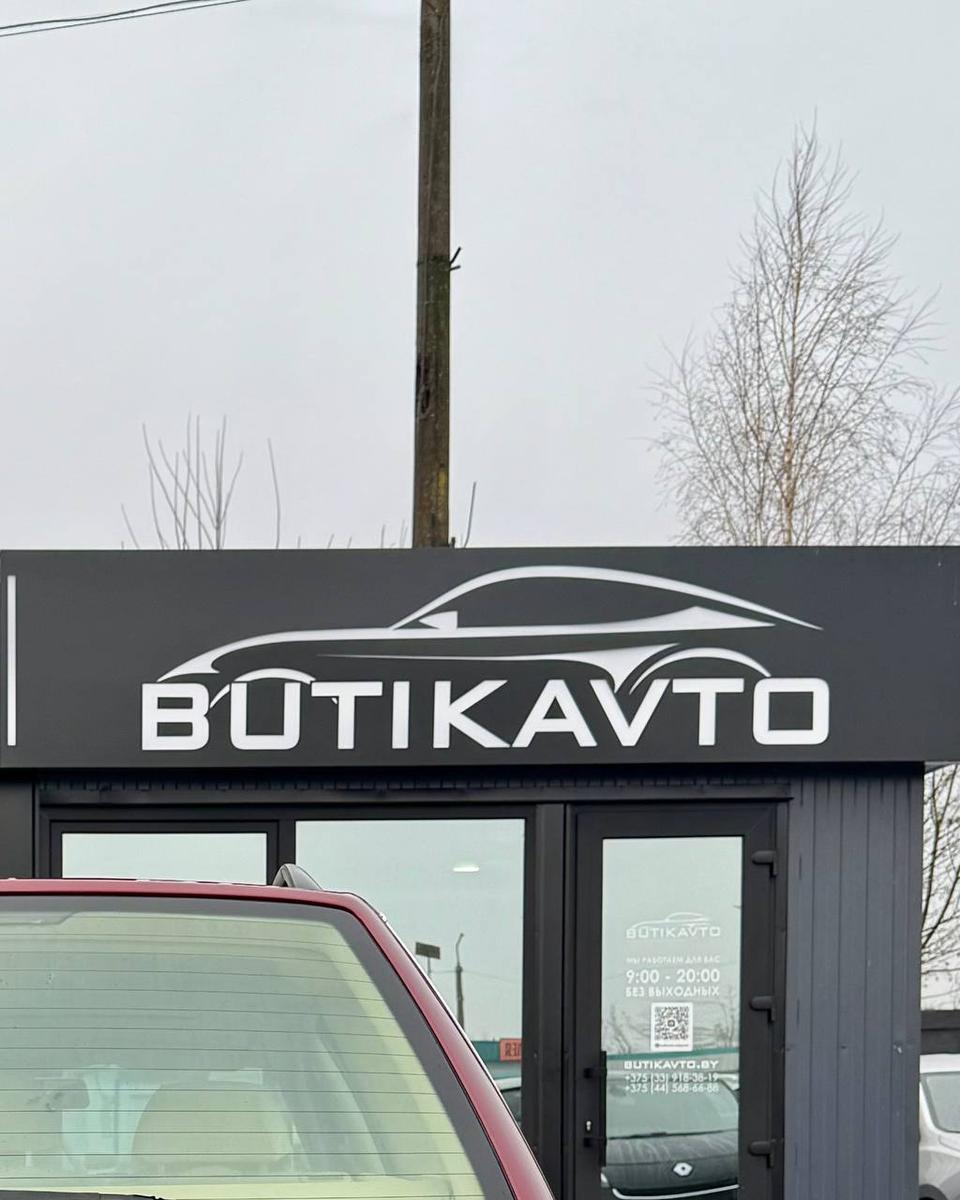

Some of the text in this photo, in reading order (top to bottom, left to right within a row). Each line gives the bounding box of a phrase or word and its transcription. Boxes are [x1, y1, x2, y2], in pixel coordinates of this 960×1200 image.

[141, 676, 831, 752] BUTIKAVTO
[626, 926, 721, 939] BUTIKAVTO
[626, 968, 660, 985] 9:00
[676, 968, 720, 983] 20:00
[626, 985, 720, 998] БЕЗ ВЫХОДНЫХ
[624, 1060, 719, 1070] BUTIKAVTO.BY
[625, 1072, 648, 1083] +375
[625, 1083, 648, 1093] +375
